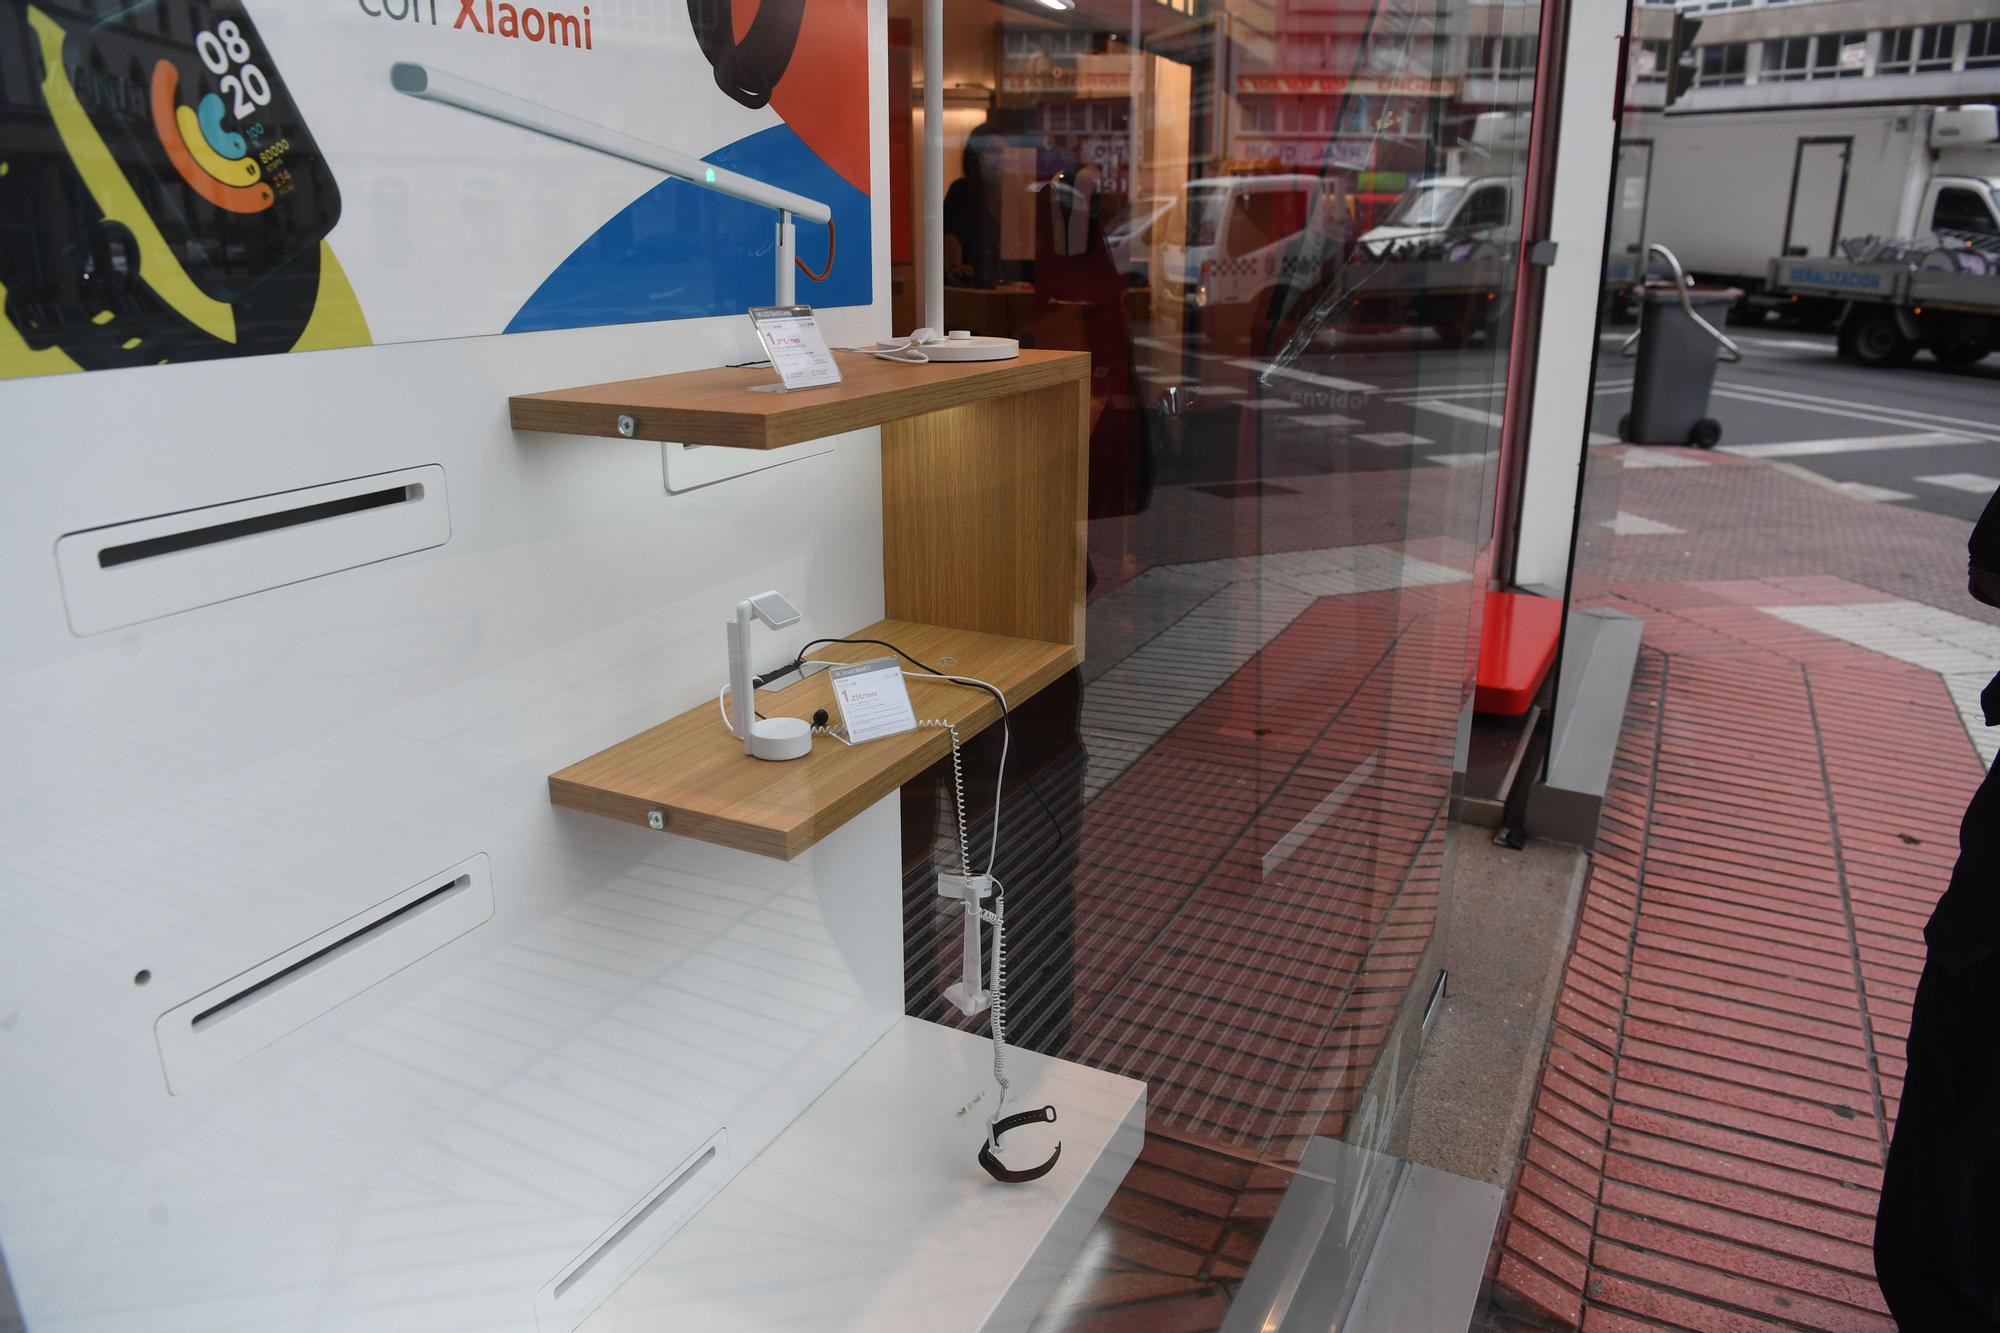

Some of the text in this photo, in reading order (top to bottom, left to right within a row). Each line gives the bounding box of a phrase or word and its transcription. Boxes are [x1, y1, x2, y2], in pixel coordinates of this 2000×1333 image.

[196, 19, 251, 75] 08
[453, 0, 593, 50] Xiaomi
[220, 63, 272, 120] 20
